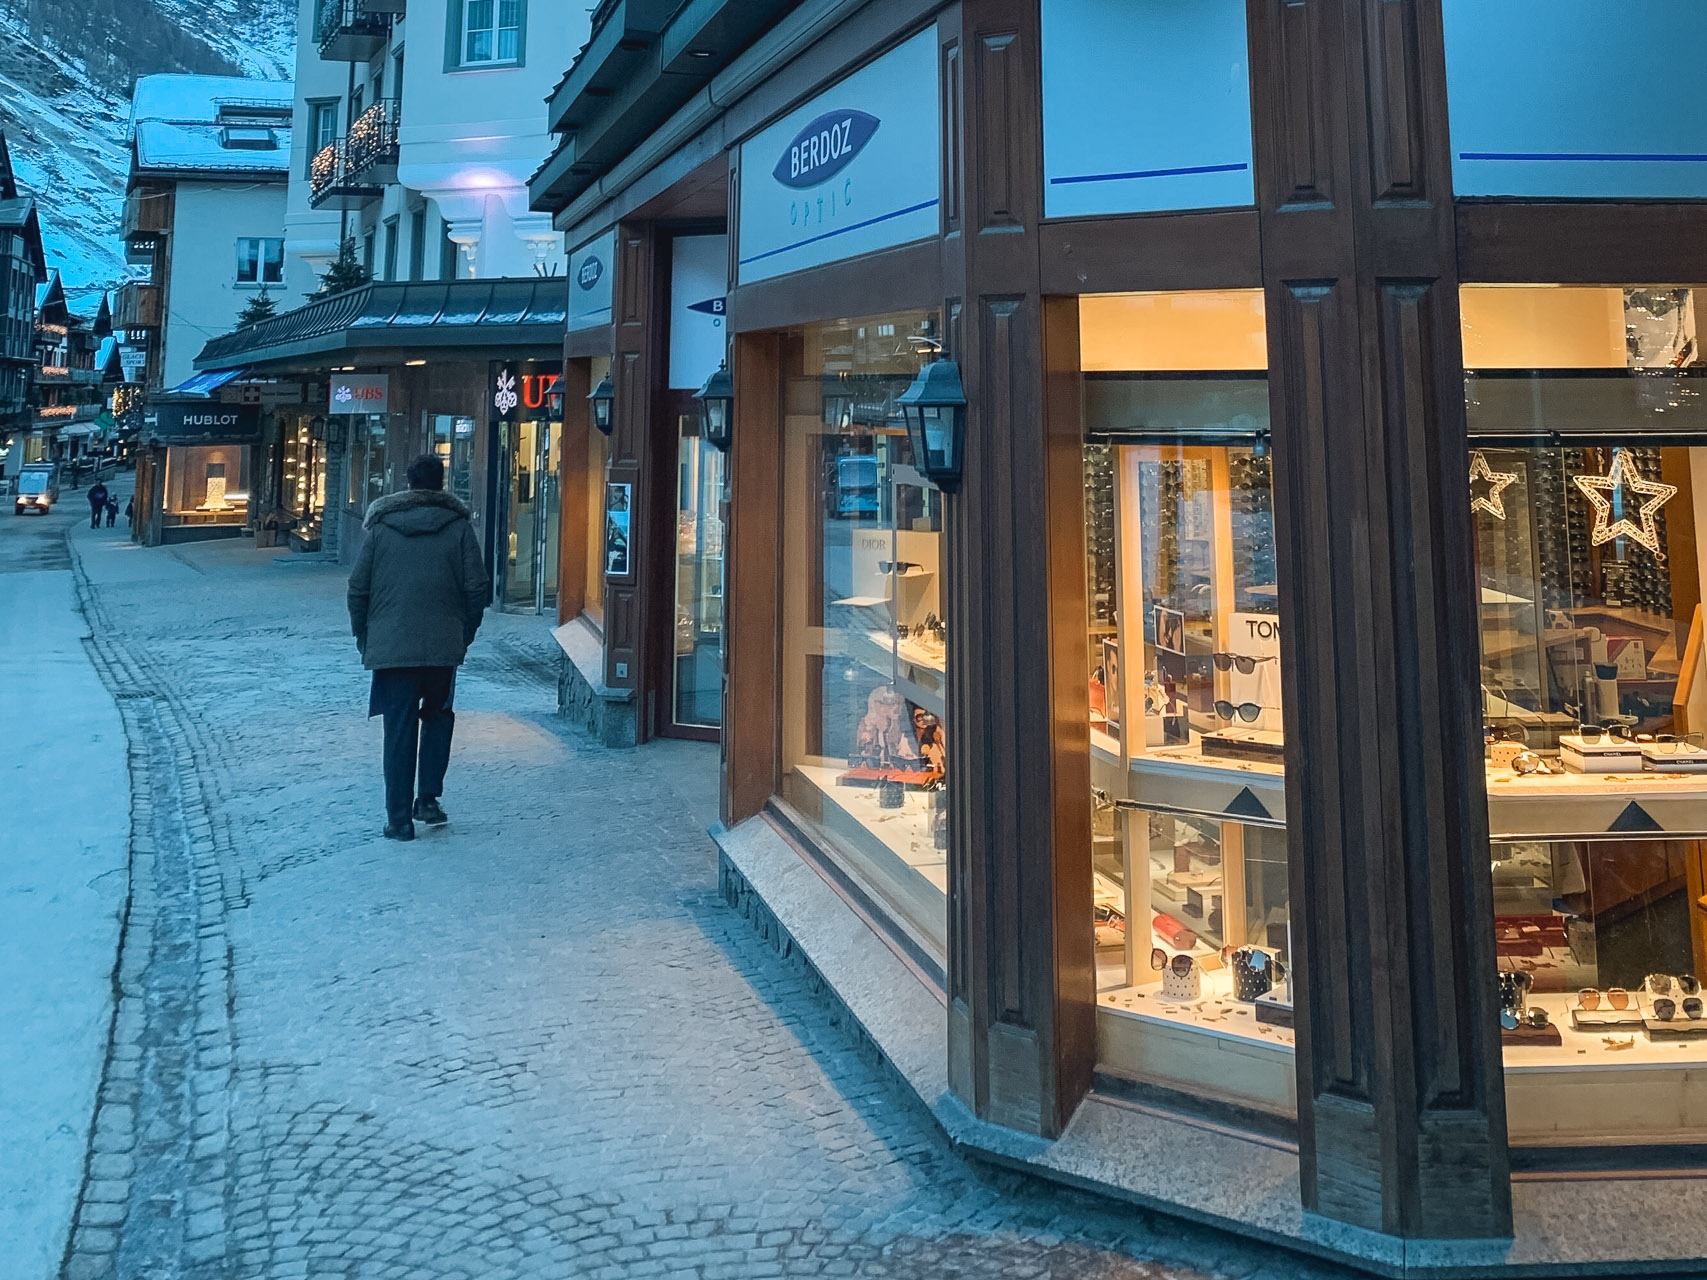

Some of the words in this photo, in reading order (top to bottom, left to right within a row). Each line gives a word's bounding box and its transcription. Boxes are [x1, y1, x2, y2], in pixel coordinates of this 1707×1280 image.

[791, 117, 852, 179] BERDOZ
[790, 177, 852, 227] OPTIC
[353, 385, 384, 400] UBS
[183, 414, 239, 426] HUBLOT
[861, 538, 887, 551] DIOR
